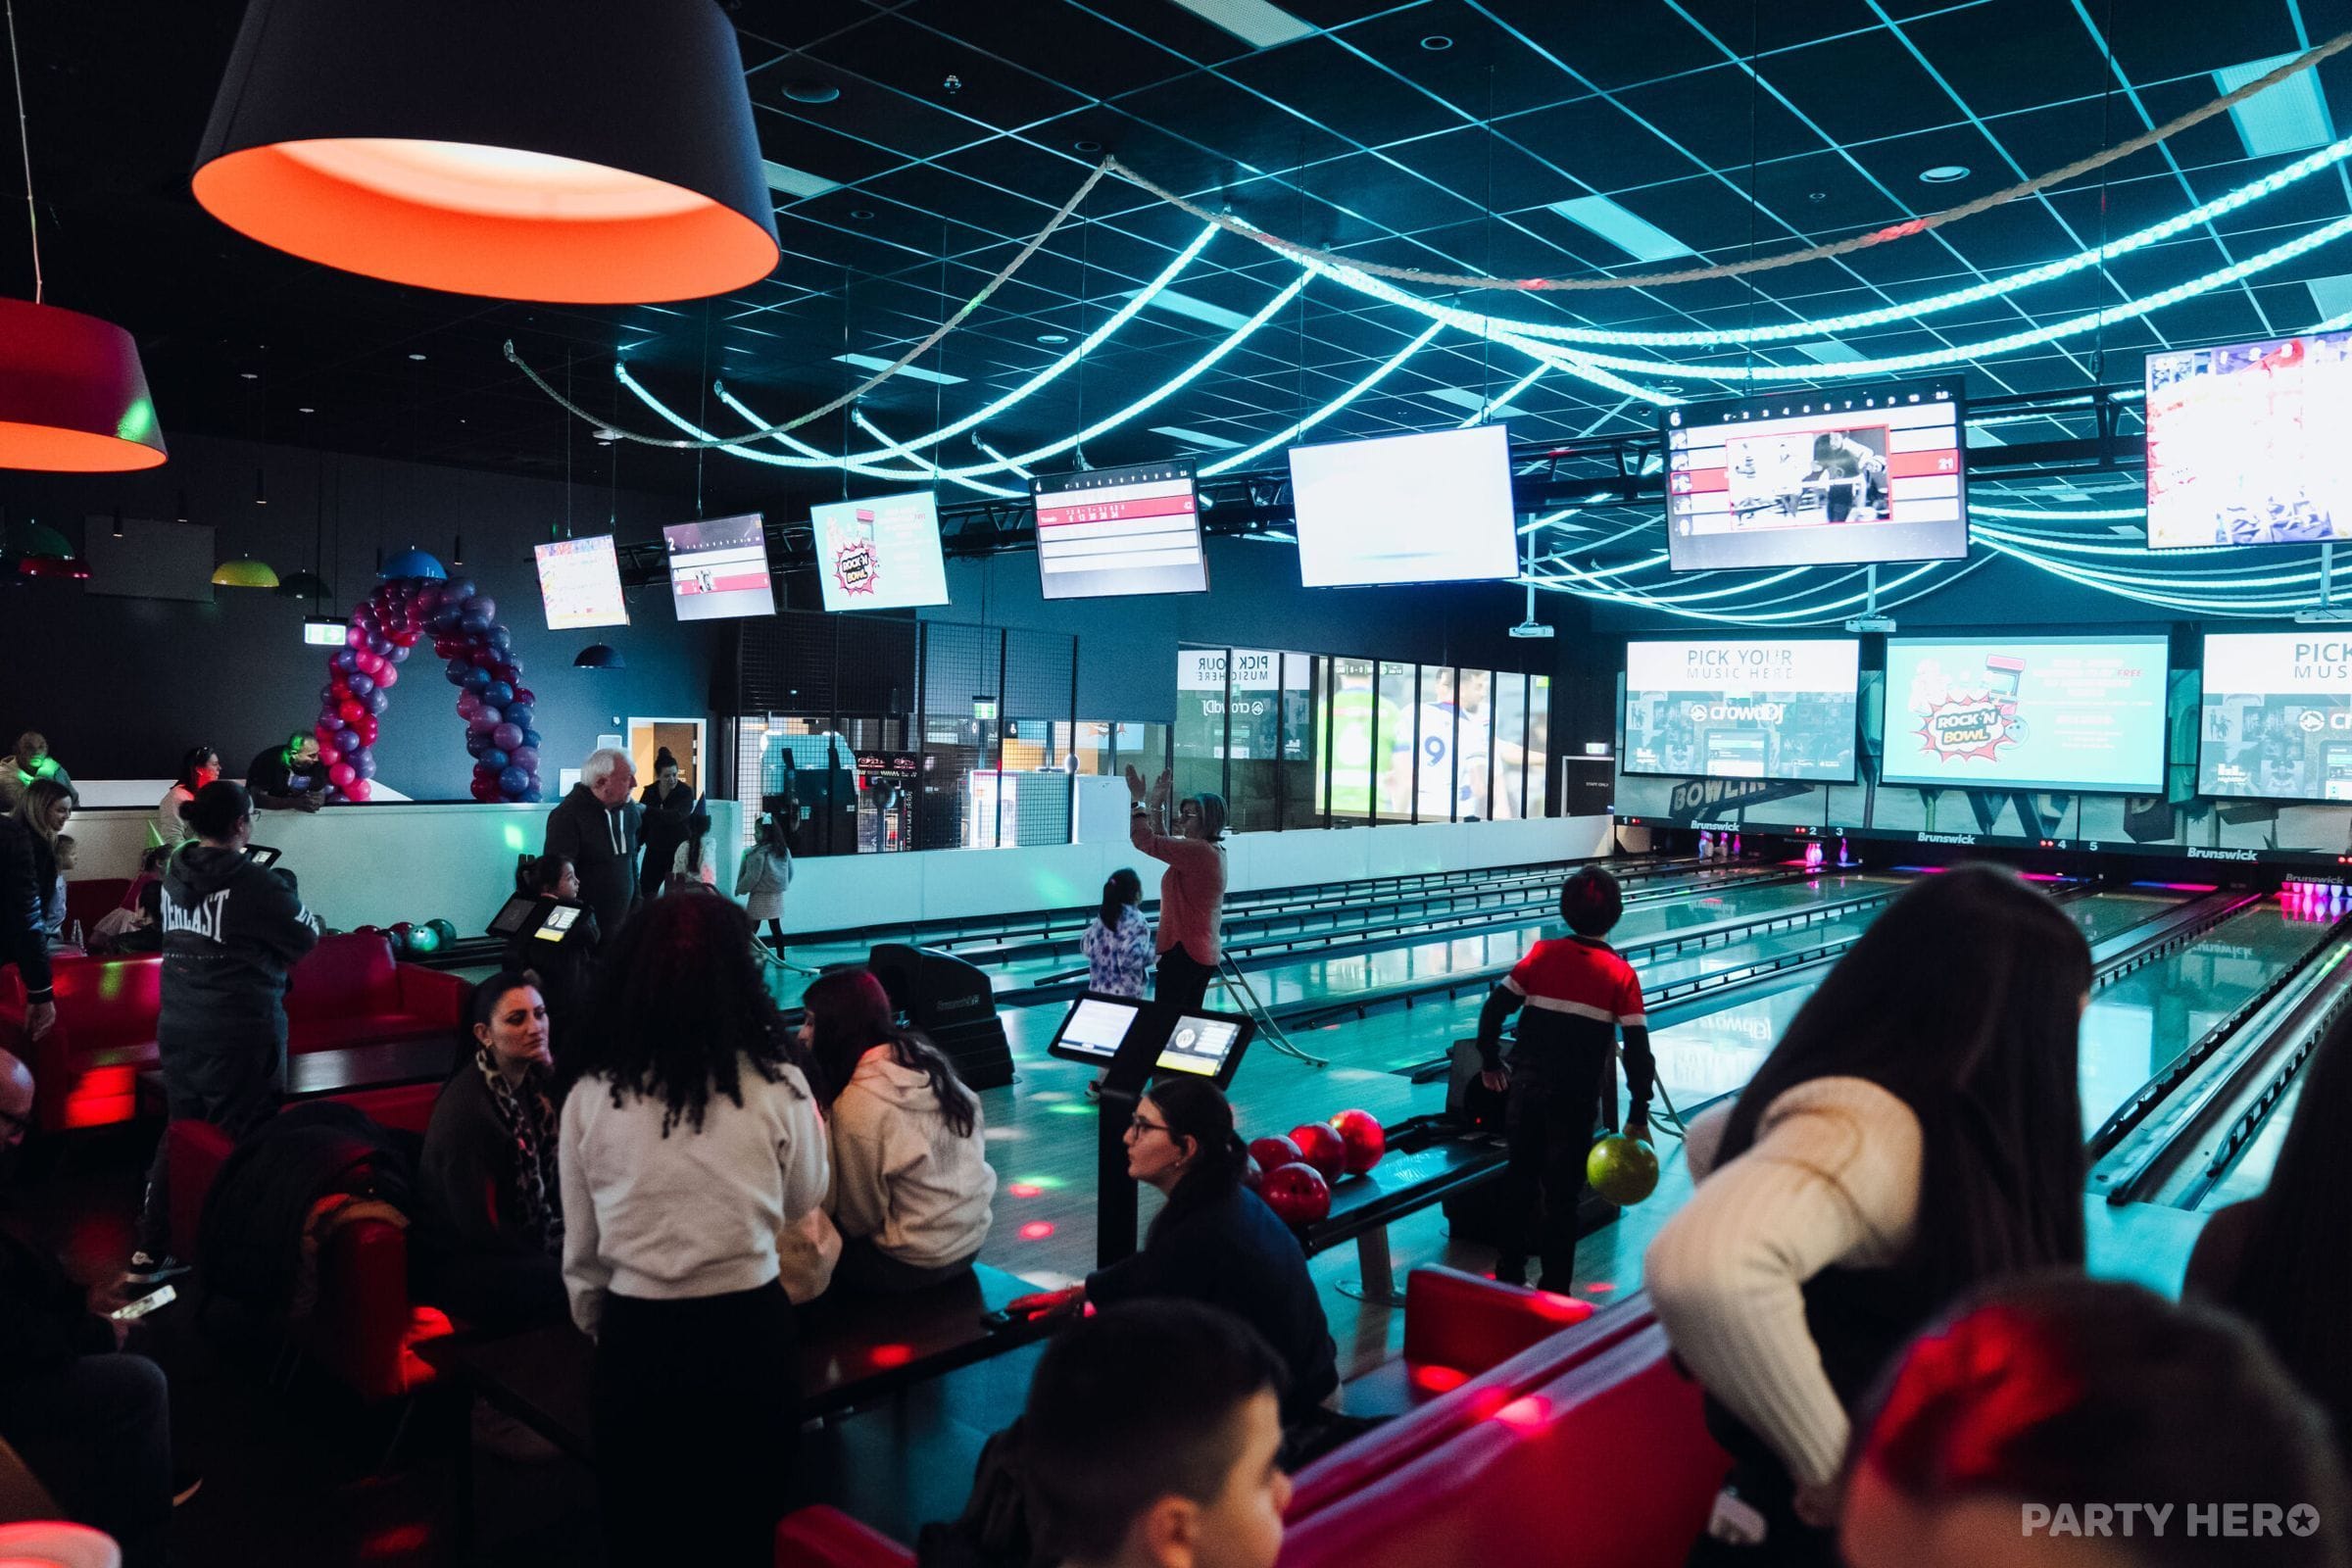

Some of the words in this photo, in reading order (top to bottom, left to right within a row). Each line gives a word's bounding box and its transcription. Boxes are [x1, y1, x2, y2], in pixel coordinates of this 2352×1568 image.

[1670, 412, 1682, 426] 6
[667, 536, 676, 552] 2
[1688, 649, 1729, 665] PICK
[1686, 666, 1740, 679] MUSIC
[1942, 728, 1989, 745] BOWL
[1424, 735, 1446, 767] 9
[1622, 815, 1629, 825] 1
[1690, 819, 1740, 832] Brunswick
[1809, 826, 1817, 836] 2
[1835, 827, 1843, 836] 3
[1918, 832, 1976, 846] Brunswick
[2057, 840, 2067, 850] 4
[2089, 842, 2098, 852] 5
[2187, 847, 2258, 862] Brunswick
[2285, 873, 2344, 885] Brunswick
